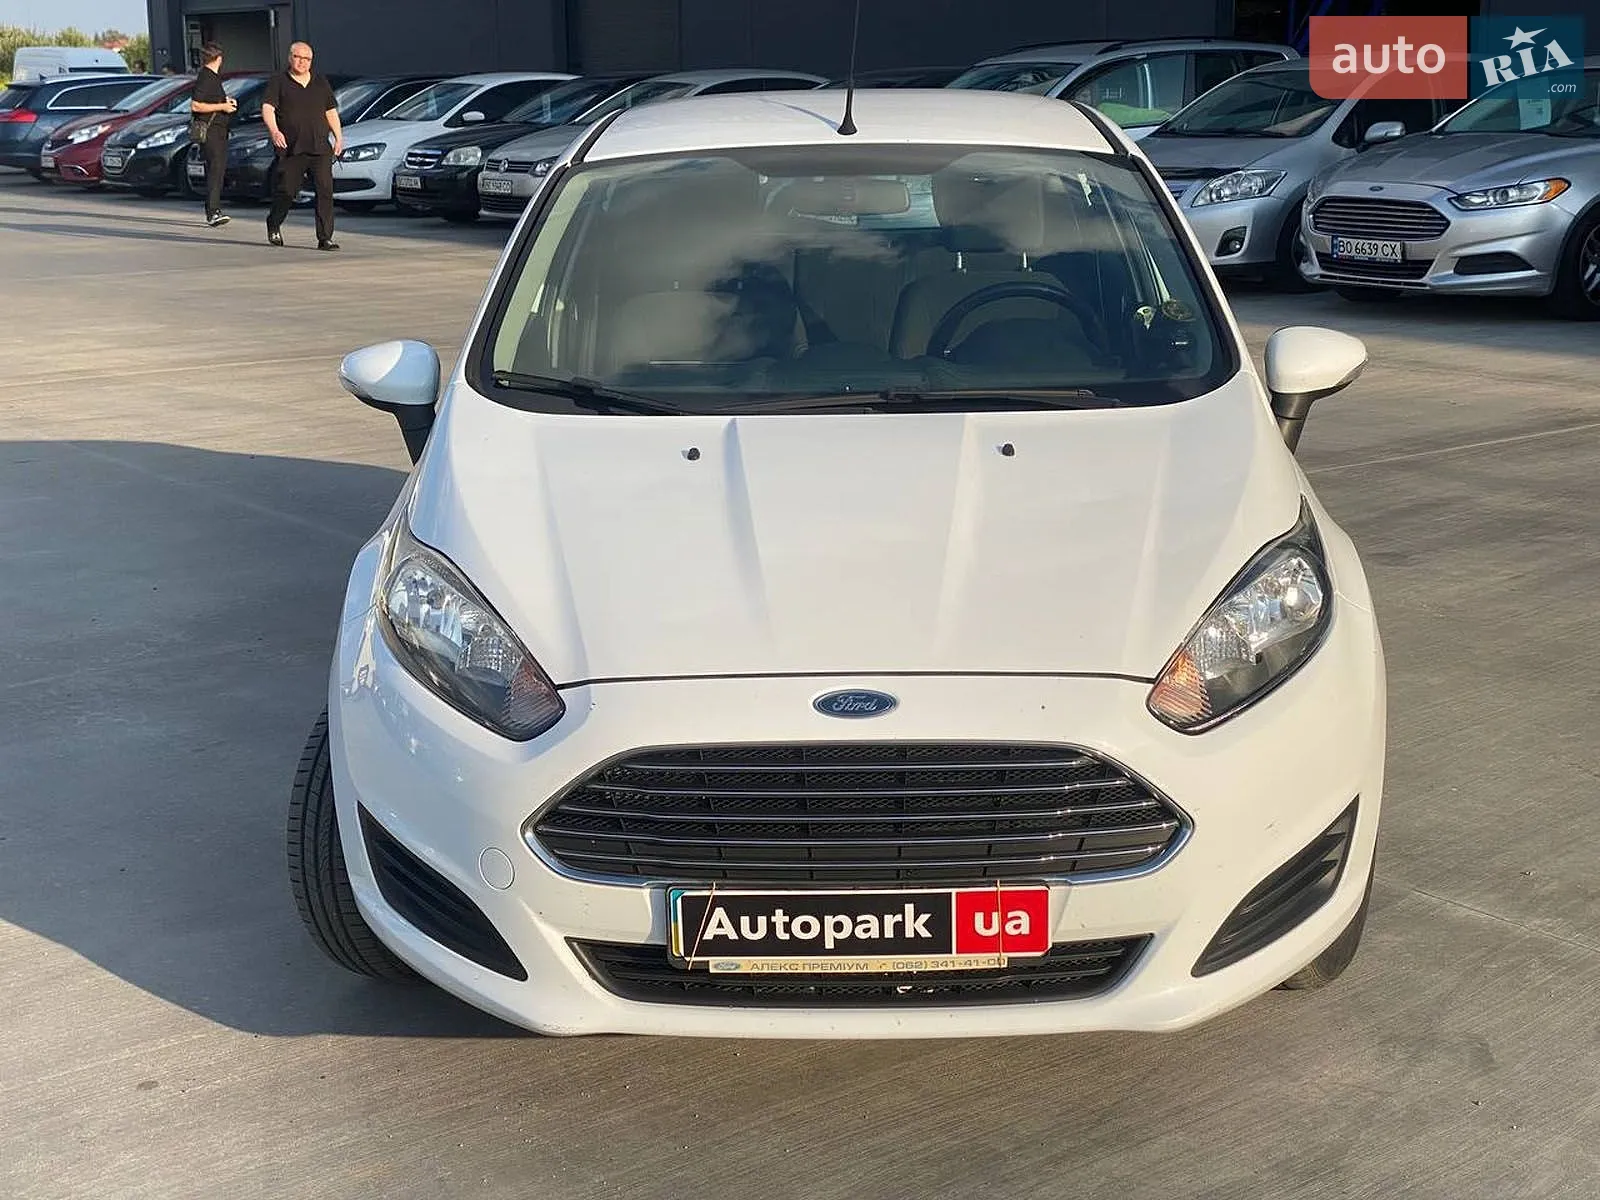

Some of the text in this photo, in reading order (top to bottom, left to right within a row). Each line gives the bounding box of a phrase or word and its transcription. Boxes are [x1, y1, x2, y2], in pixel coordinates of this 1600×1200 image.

[1338, 240, 1398, 257] BO 6639 CX
[832, 695, 878, 711] Ford
[702, 903, 1032, 949] Autopark ua
[750, 962, 799, 972] АЛЕКС
[803, 961, 869, 971] ПРЕМІУМ
[892, 960, 928, 970] (062)
